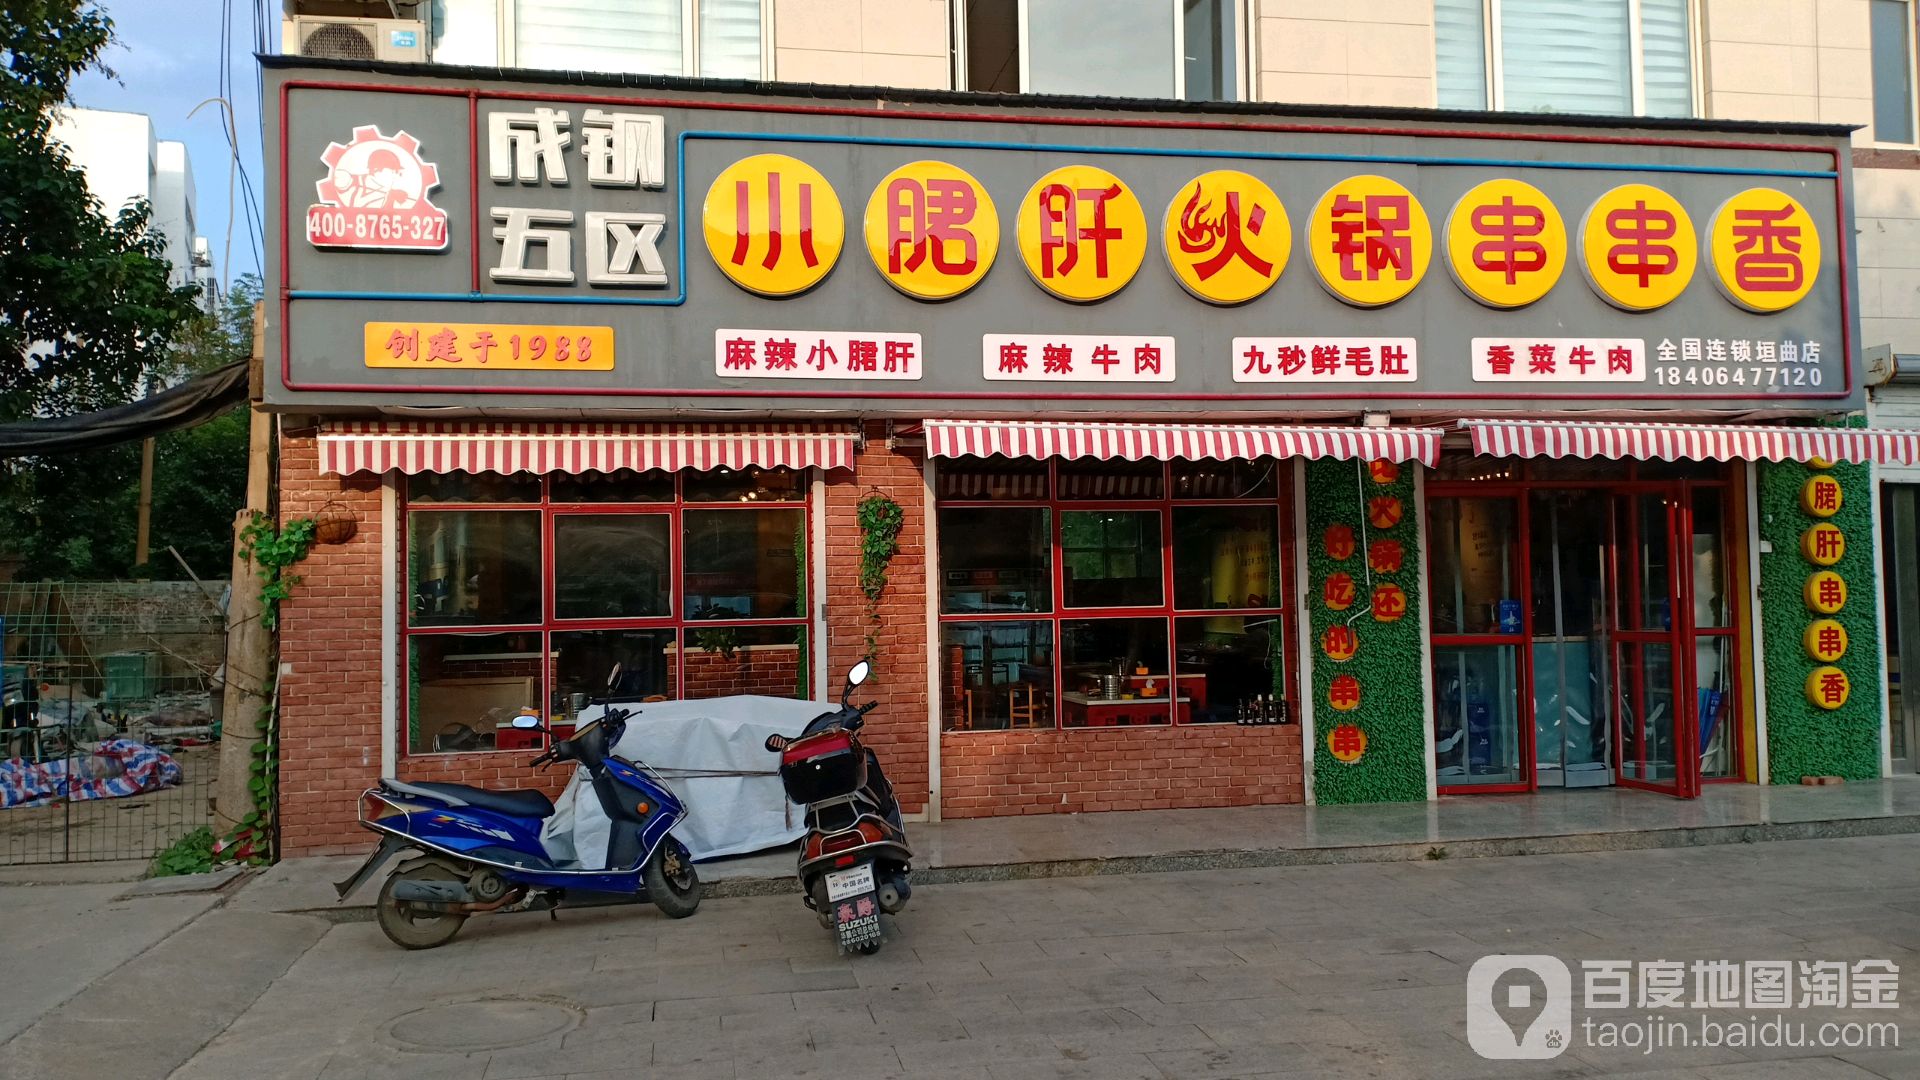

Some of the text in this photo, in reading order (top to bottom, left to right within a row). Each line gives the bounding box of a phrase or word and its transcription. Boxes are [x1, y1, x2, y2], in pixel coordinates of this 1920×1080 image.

[488, 108, 665, 189] 成钢
[309, 214, 446, 243] 400-8765-327
[489, 206, 668, 286] 五区
[384, 328, 593, 363] 创建于1988
[998, 342, 1162, 375] 麻辣牛肉
[1242, 345, 1410, 376] 九秒鲜毛肚
[1486, 344, 1634, 375] 香菜牛肉
[1656, 338, 1822, 365] 全国连锁垣曲店
[1654, 367, 1823, 388] 18406477120
[838, 915, 878, 931] SUZUKI
